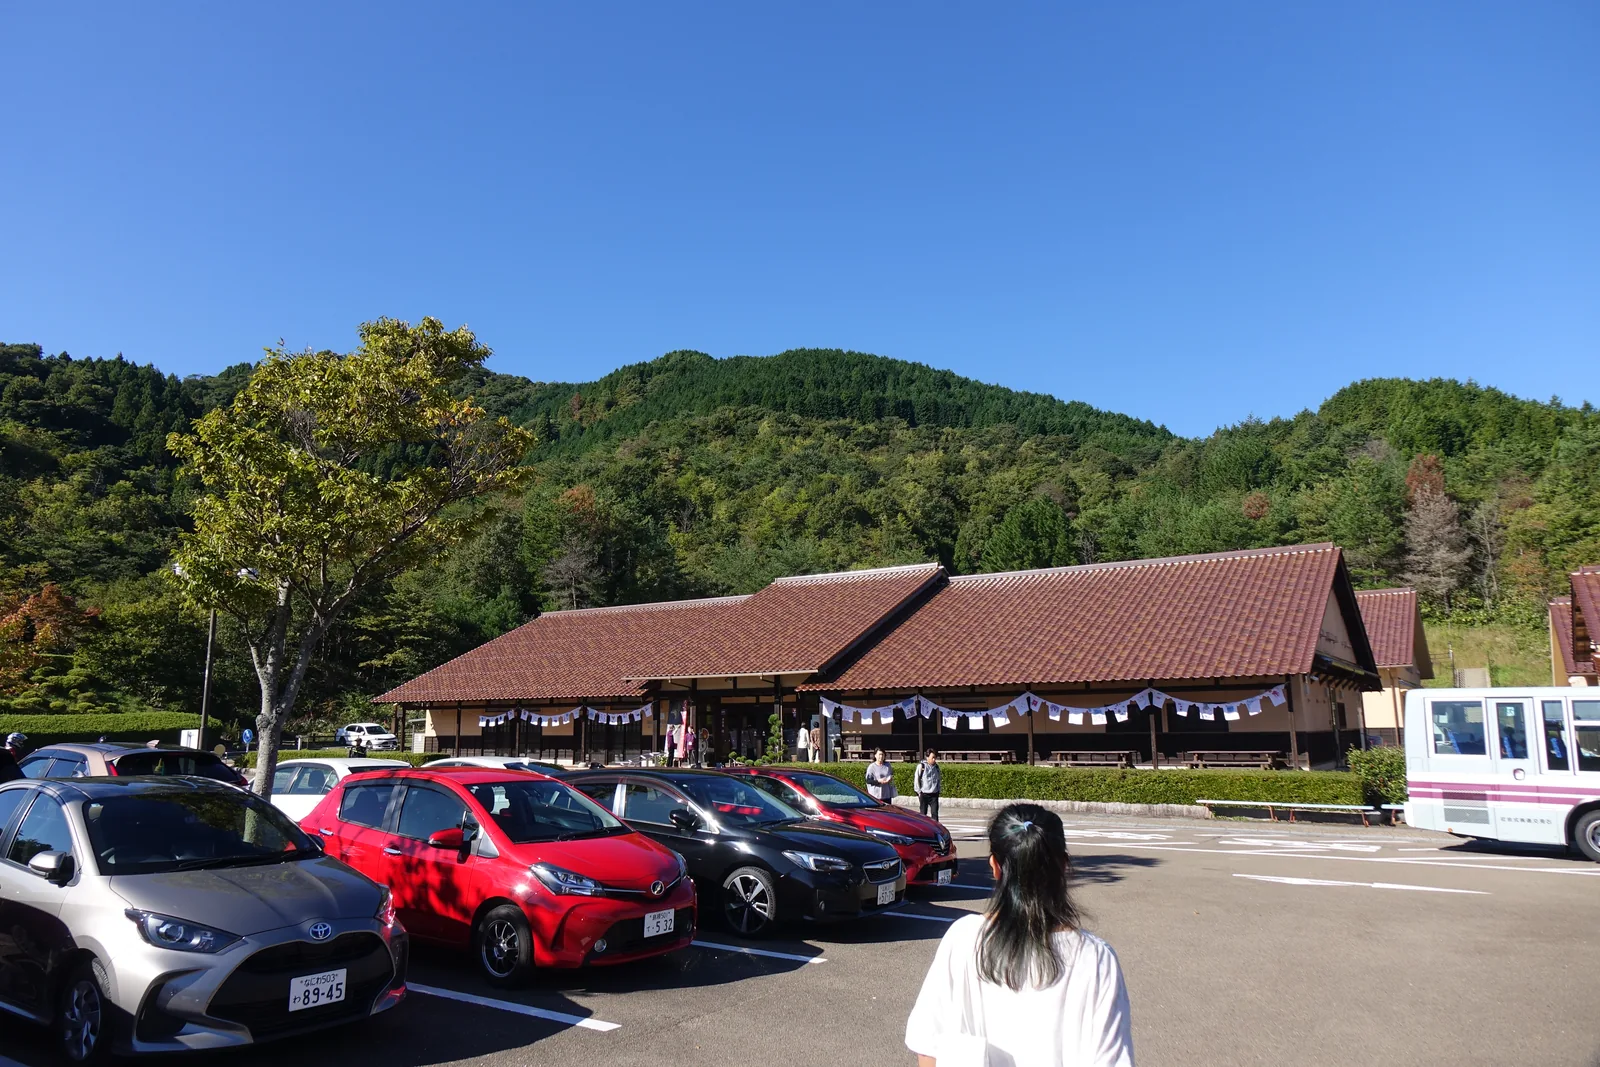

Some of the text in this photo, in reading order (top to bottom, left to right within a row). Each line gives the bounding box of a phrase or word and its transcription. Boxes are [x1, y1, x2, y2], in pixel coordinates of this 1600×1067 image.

[304, 973, 336, 987] なにわ503
[302, 982, 343, 1005] 89-45
